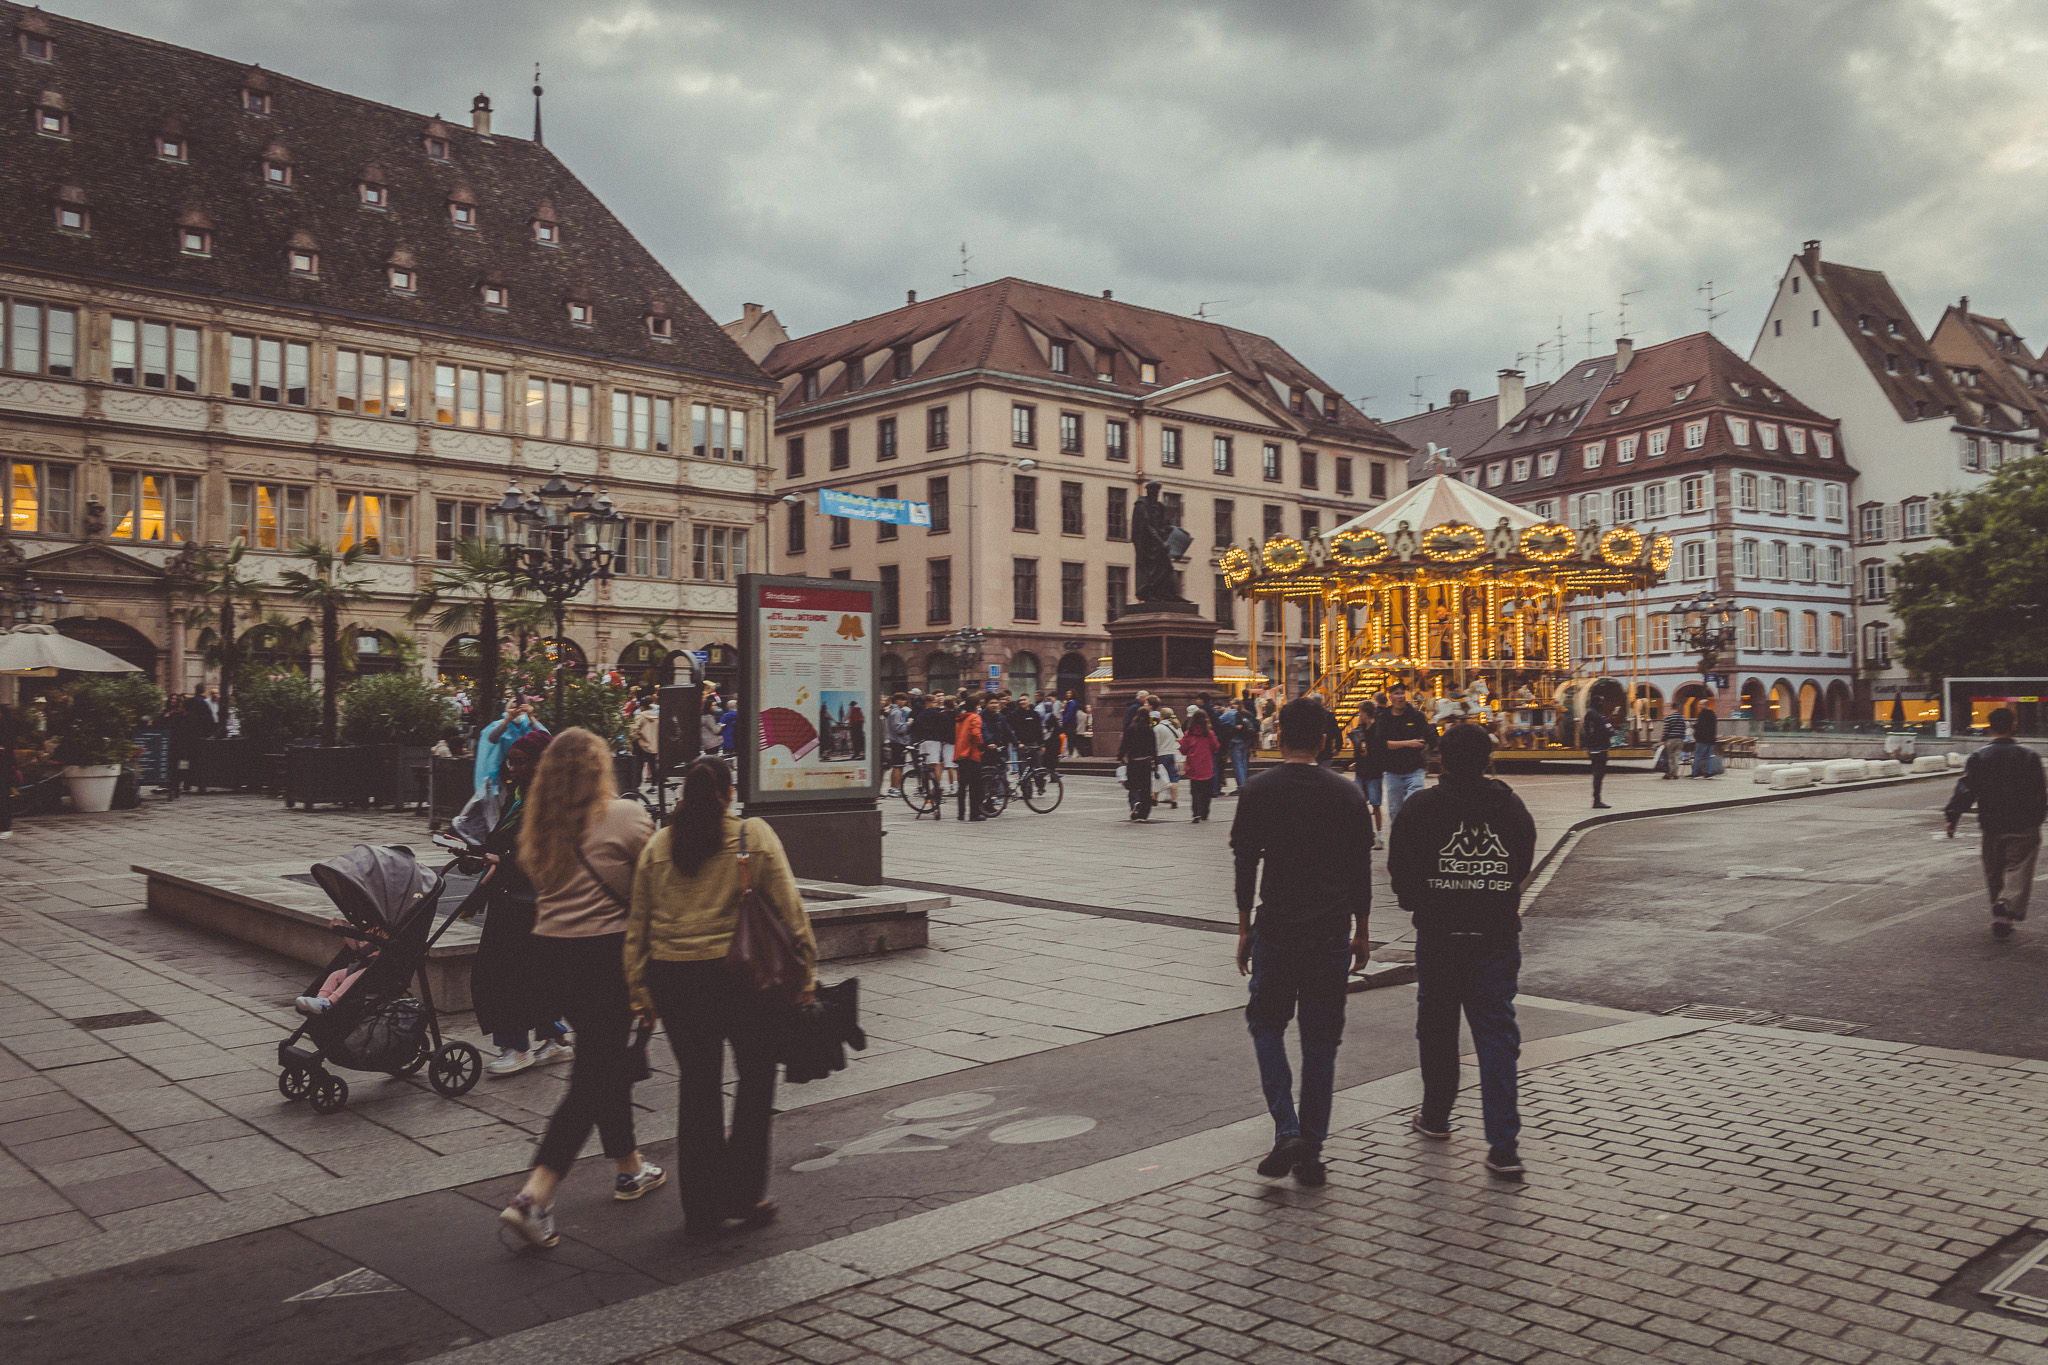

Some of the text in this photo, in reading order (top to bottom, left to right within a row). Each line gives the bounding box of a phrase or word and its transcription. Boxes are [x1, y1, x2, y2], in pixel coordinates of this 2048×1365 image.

[1439, 858, 1508, 875] Kappa
[1427, 879, 1513, 891] TRAINING DEP
